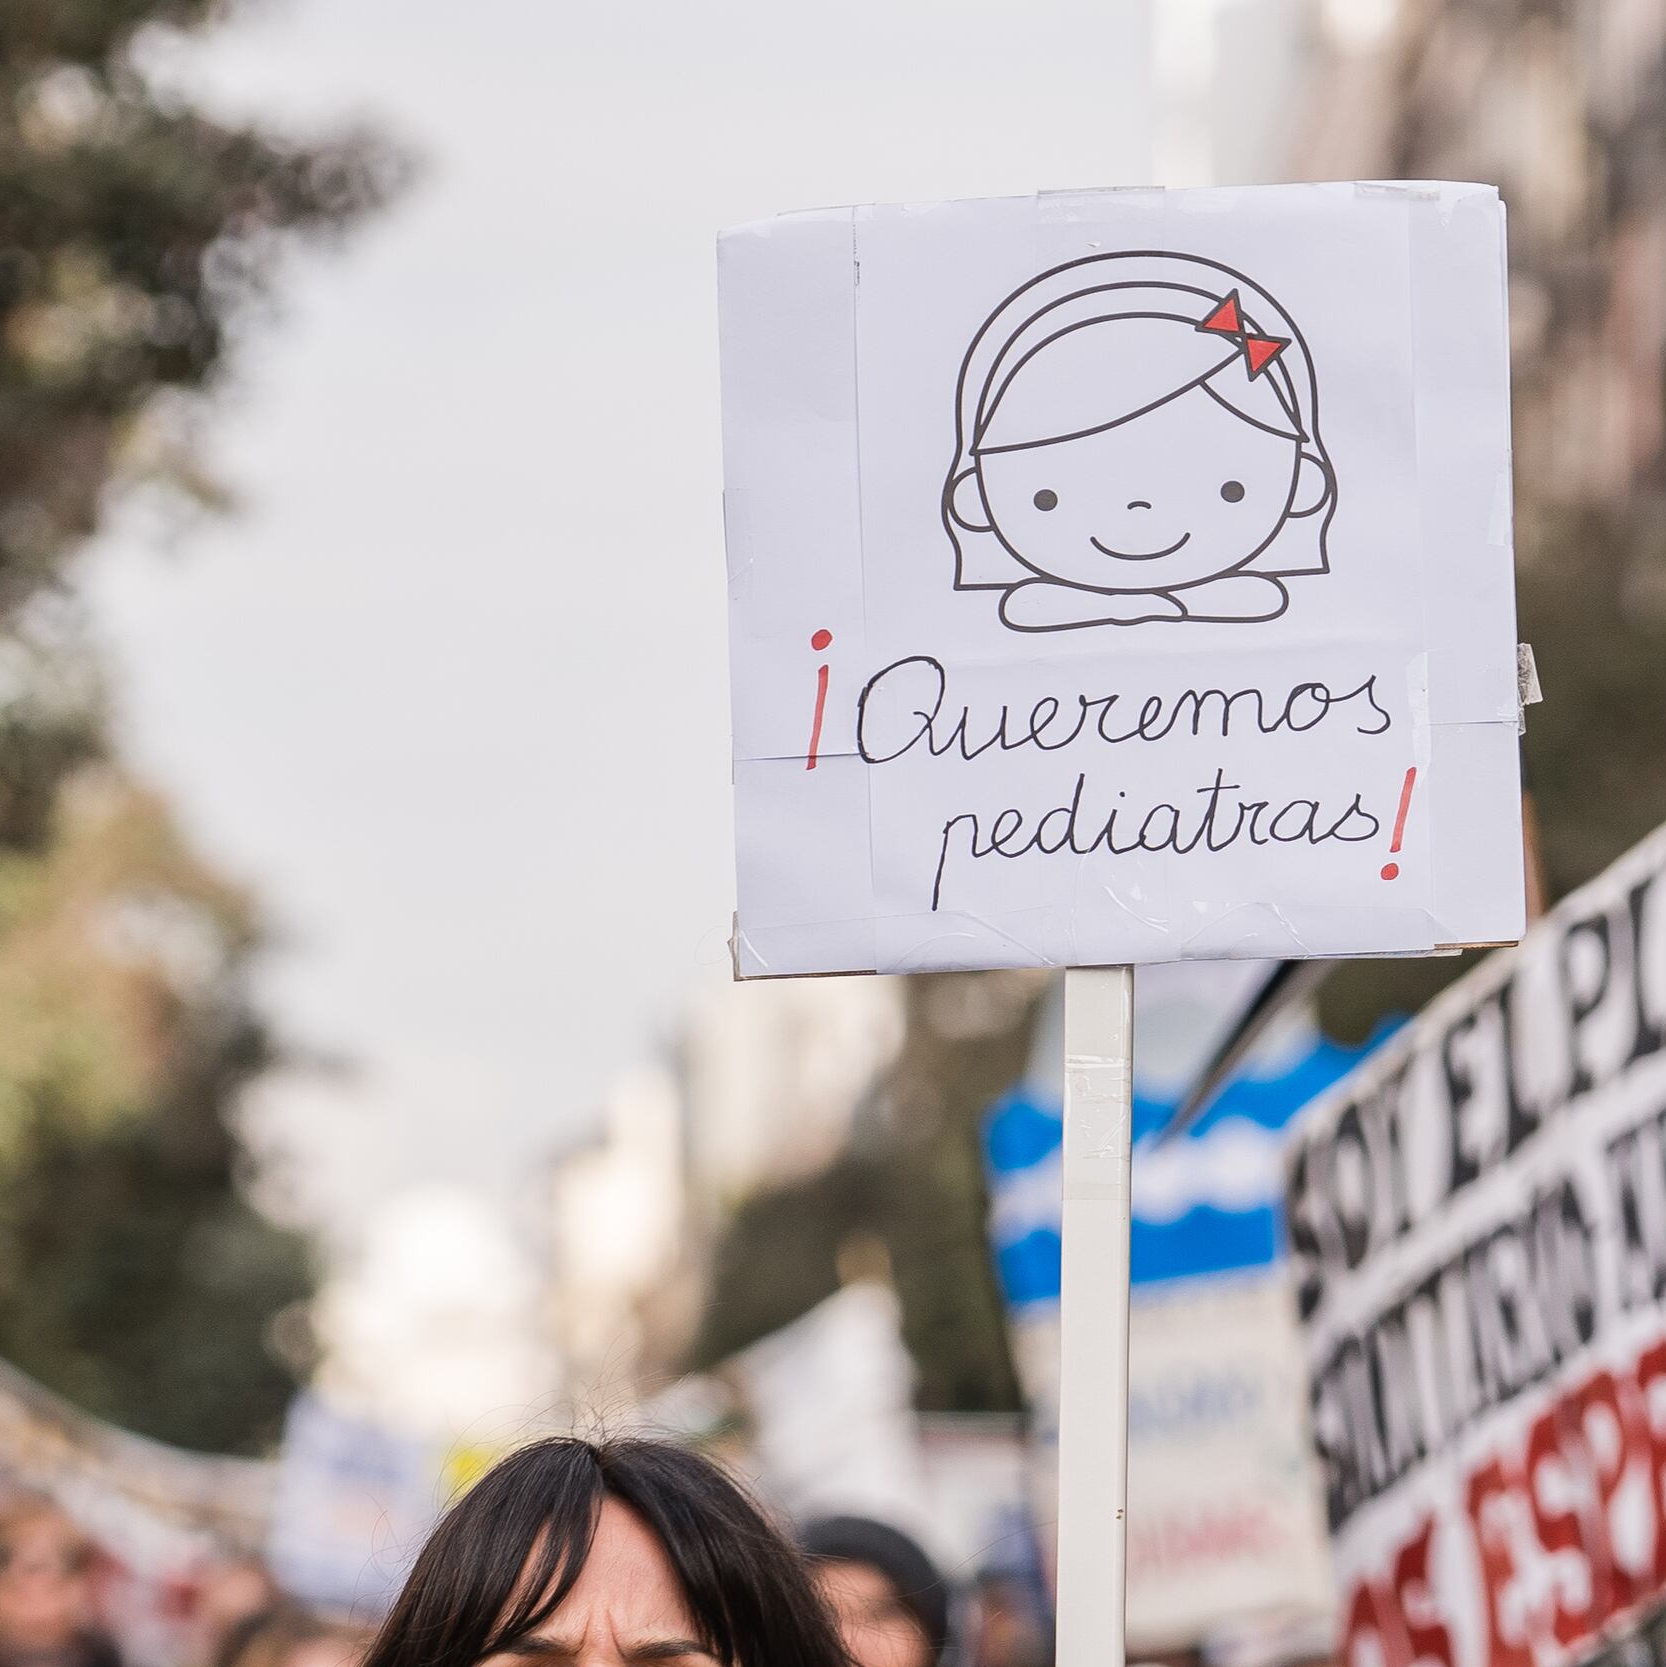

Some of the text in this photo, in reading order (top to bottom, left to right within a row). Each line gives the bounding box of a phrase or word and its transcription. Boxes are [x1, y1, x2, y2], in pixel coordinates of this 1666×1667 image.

[805, 629, 1393, 771] ¡Queremos
[932, 767, 1418, 912] pediatras!
[1441, 985, 1539, 1190] EL
